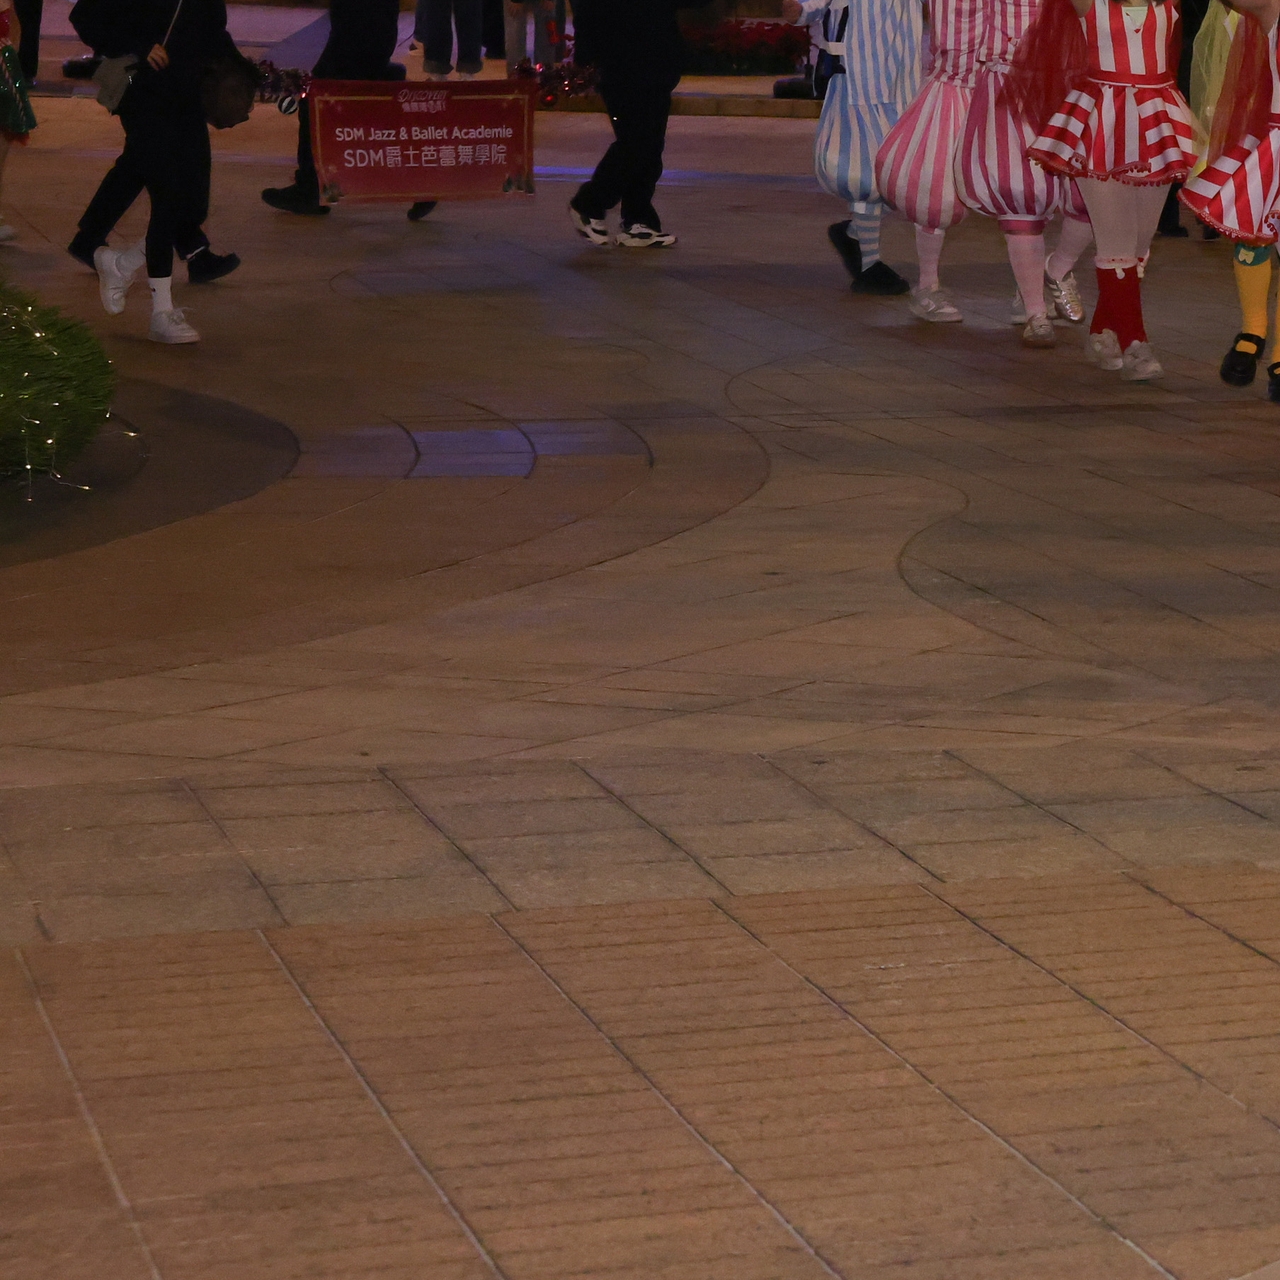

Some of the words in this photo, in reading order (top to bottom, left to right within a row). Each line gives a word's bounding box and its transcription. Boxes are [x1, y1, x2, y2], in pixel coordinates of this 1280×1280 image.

[335, 127, 365, 141] SDM
[368, 127, 396, 141] Jazz
[399, 127, 408, 140] &
[412, 126, 448, 140] Ballet
[451, 125, 513, 139] Academie
